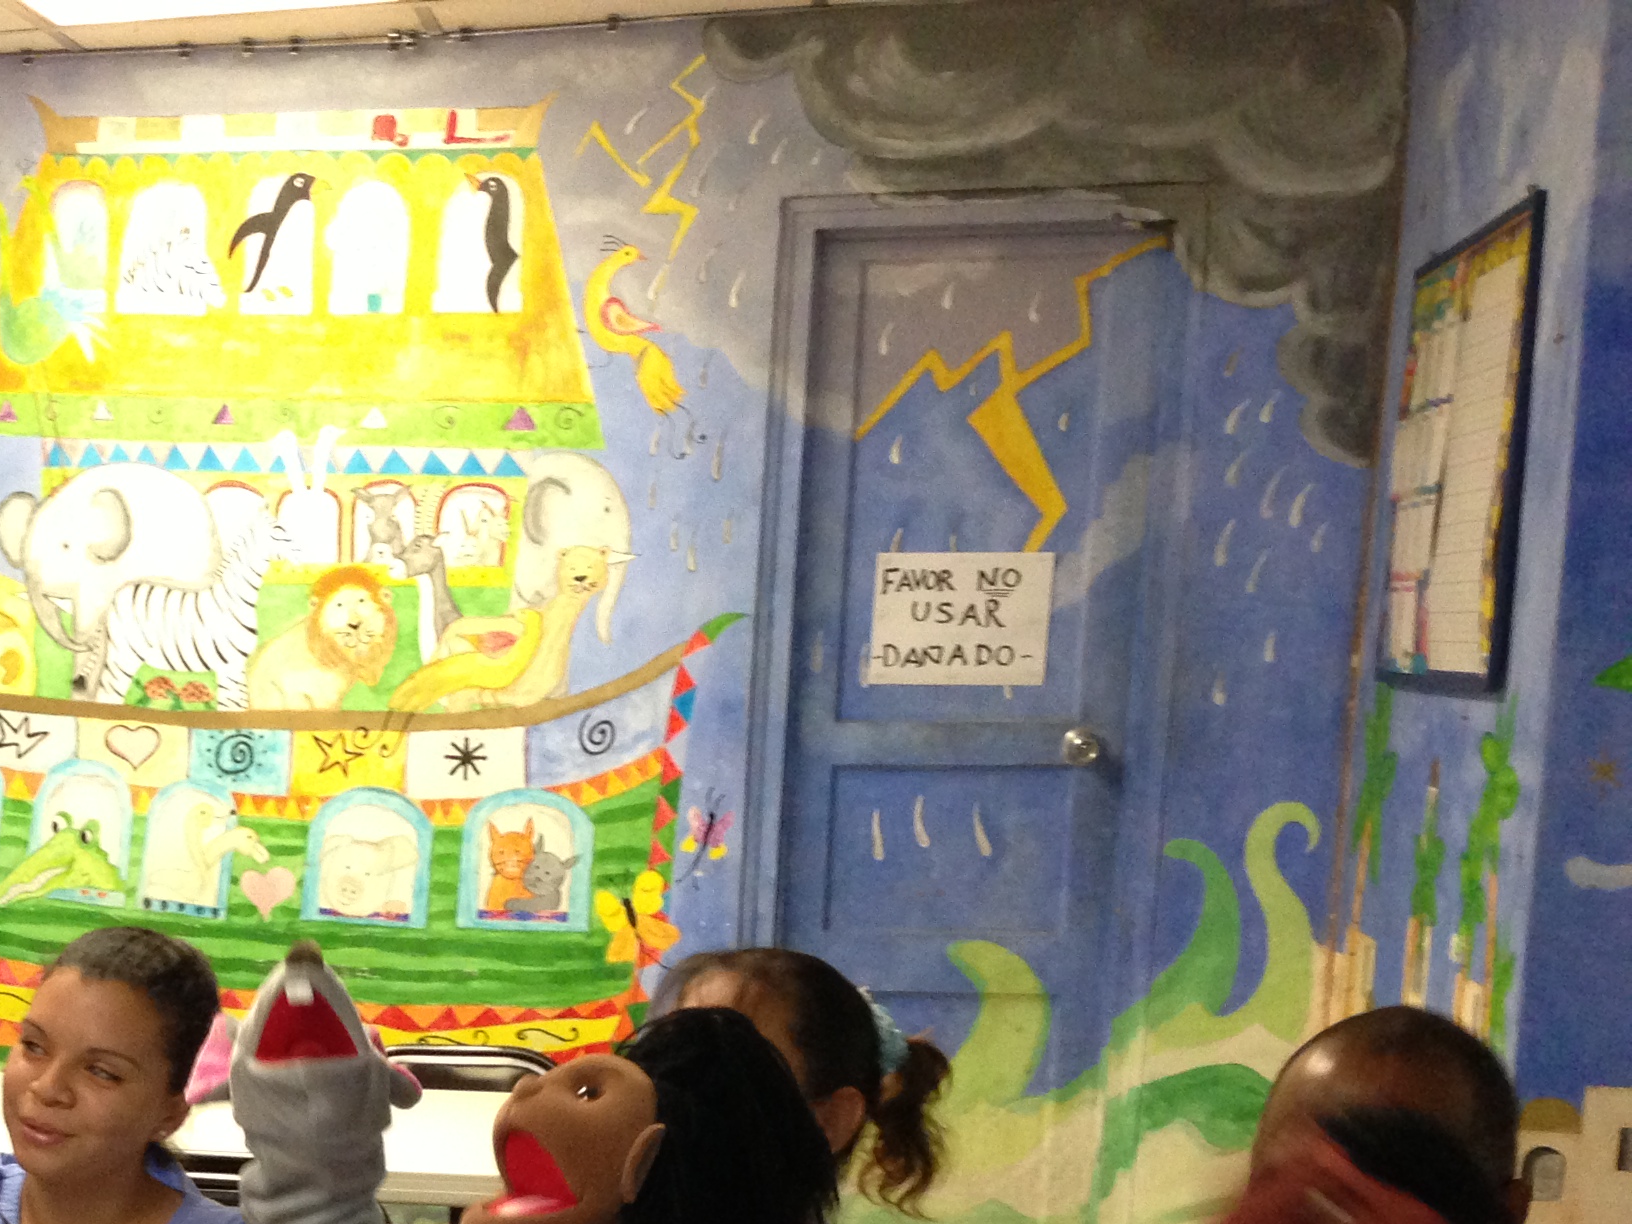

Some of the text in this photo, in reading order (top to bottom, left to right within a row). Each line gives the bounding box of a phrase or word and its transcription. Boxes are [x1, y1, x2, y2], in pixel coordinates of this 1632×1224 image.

[880, 567, 1022, 594] FAVOR NO
[910, 599, 1006, 628] USAR
